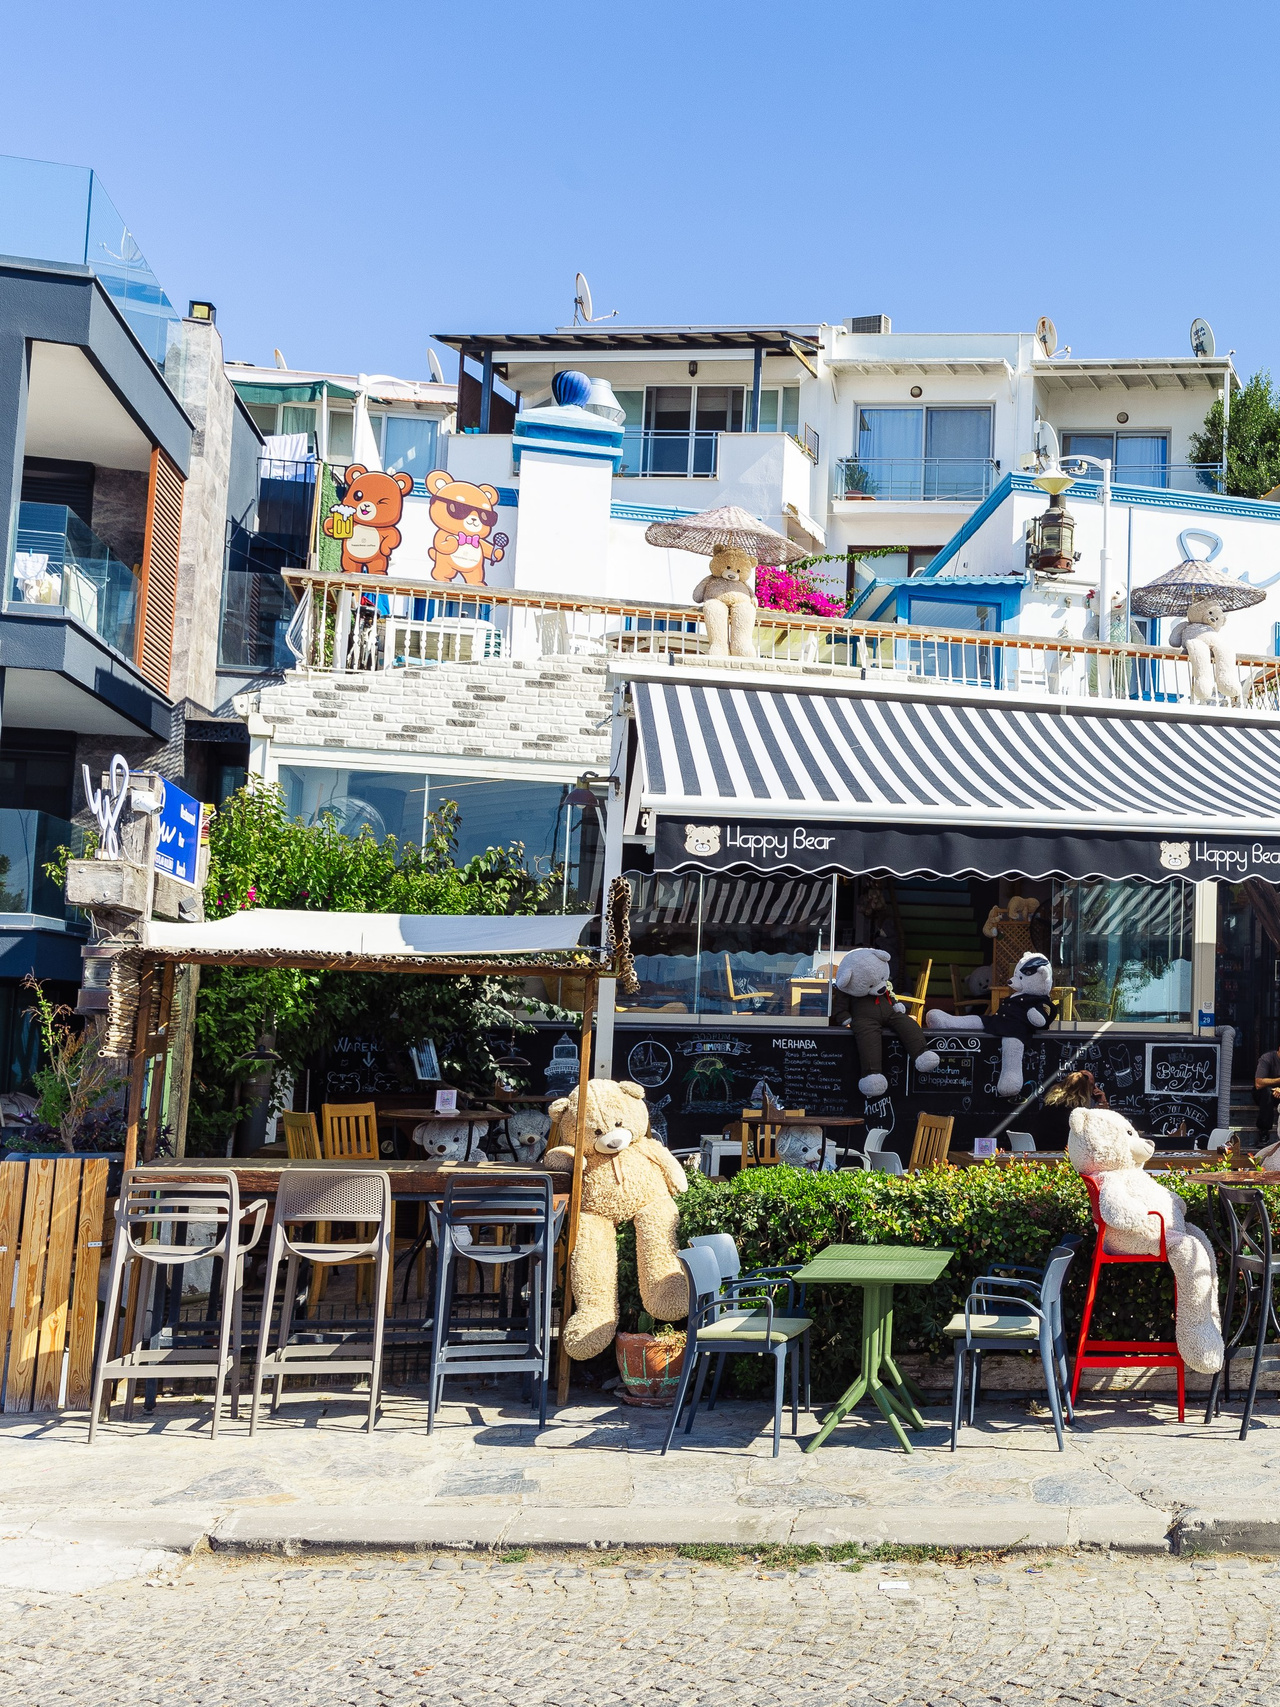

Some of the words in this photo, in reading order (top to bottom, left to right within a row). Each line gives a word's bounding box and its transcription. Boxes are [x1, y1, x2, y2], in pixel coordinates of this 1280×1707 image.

[727, 825, 788, 859] Happy
[793, 827, 836, 850] Bear
[1195, 841, 1248, 872] Happy
[772, 1038, 818, 1050] MERHABA
[864, 1096, 895, 1118] happy
